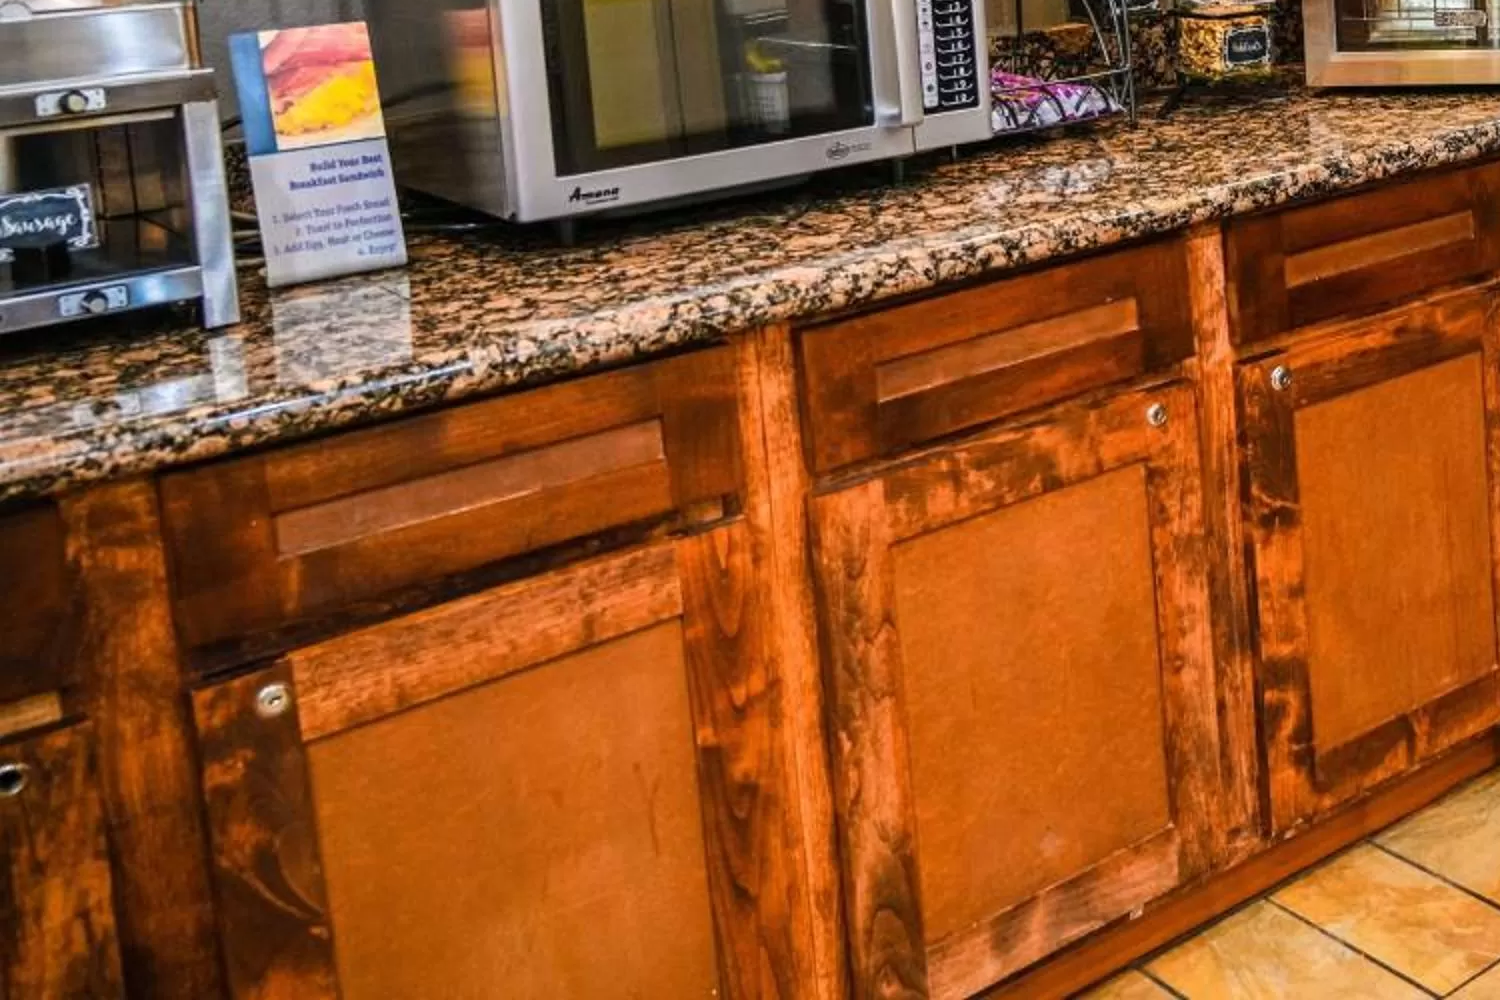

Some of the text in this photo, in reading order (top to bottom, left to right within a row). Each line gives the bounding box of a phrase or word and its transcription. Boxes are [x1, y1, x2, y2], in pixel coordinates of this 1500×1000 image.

[310, 154, 383, 172] Build Your Best
[289, 168, 384, 191] Breakfast Sandwich
[569, 186, 620, 202] Amana
[0, 213, 77, 238] Sausage
